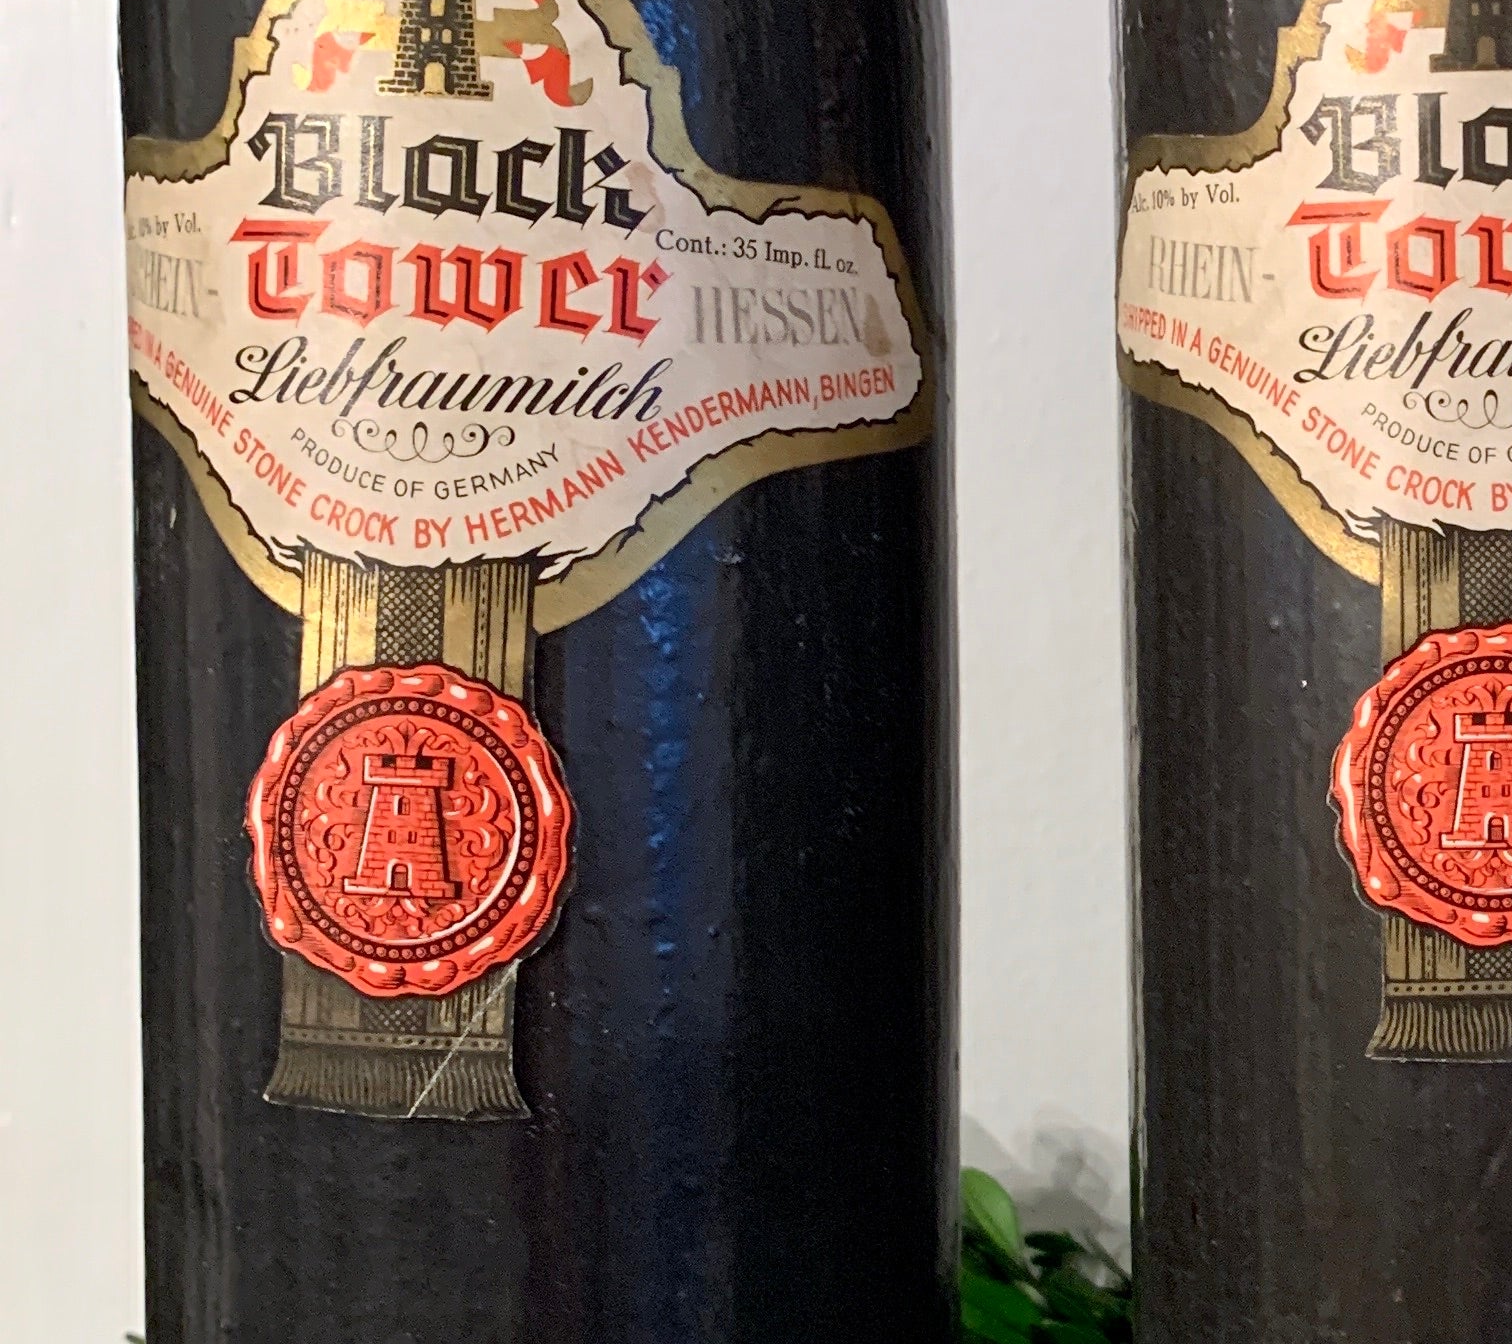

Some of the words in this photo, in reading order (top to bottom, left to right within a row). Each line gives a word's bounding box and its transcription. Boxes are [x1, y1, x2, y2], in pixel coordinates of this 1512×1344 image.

[246, 111, 658, 234] Black
[1151, 189, 1175, 208] 10%
[1181, 188, 1198, 208] by
[1205, 183, 1239, 204] Vol.
[155, 216, 169, 238] by
[174, 213, 200, 233] Vol.
[656, 229, 726, 256] Cont.:
[733, 237, 757, 259] 35
[766, 242, 808, 269] Imp.
[836, 261, 858, 274] oz.
[228, 218, 676, 347] Tower
[1148, 236, 1275, 303] RHEIN-
[691, 286, 863, 346] HESSEN
[229, 337, 675, 422] Liebfraumilch
[1122, 303, 1166, 340] SHIPPED
[1172, 318, 1187, 347] IN
[1190, 327, 1202, 356] A
[1208, 336, 1301, 417] GENUINE
[1301, 405, 1380, 479] STONE
[1387, 465, 1476, 511] CROCK
[164, 352, 234, 437] GENUINE
[233, 429, 303, 509] STONE
[309, 494, 400, 547] CROCK
[413, 518, 451, 550] BY
[465, 456, 626, 546] HERMANN
[821, 366, 895, 401] BINGEN
[291, 427, 386, 495] PRODUCE
[394, 482, 425, 499] OF
[434, 443, 564, 500] GERMANY
[1361, 402, 1459, 461] PRODUCE
[1468, 446, 1497, 464] OF
